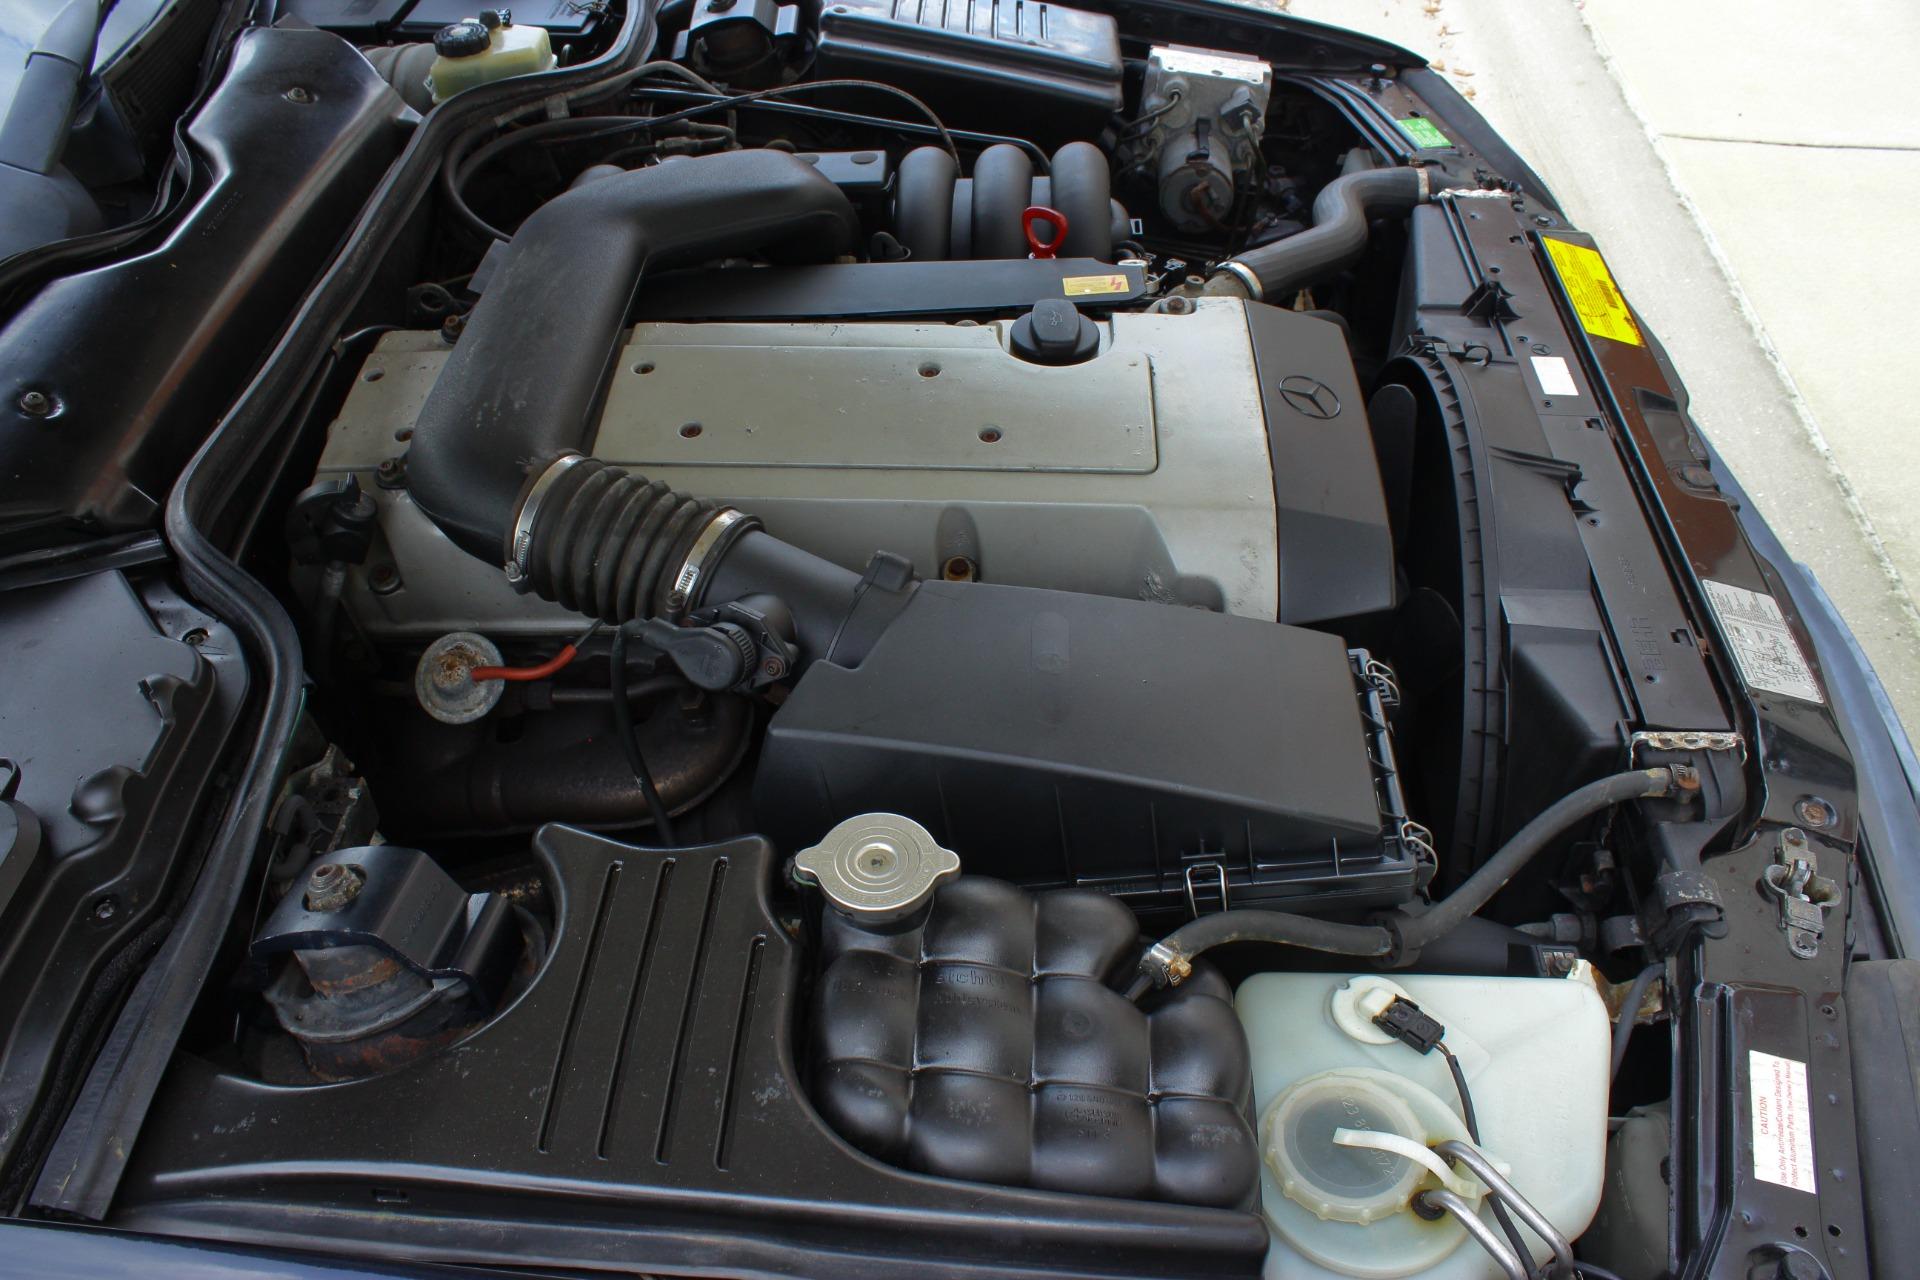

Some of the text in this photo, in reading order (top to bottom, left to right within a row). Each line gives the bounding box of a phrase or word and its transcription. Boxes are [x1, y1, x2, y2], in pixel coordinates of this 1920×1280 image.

[1760, 1096, 1769, 1135] CAUTION
[1772, 1060, 1788, 1184] Use Only Antifreeze/Coolant Designed To
